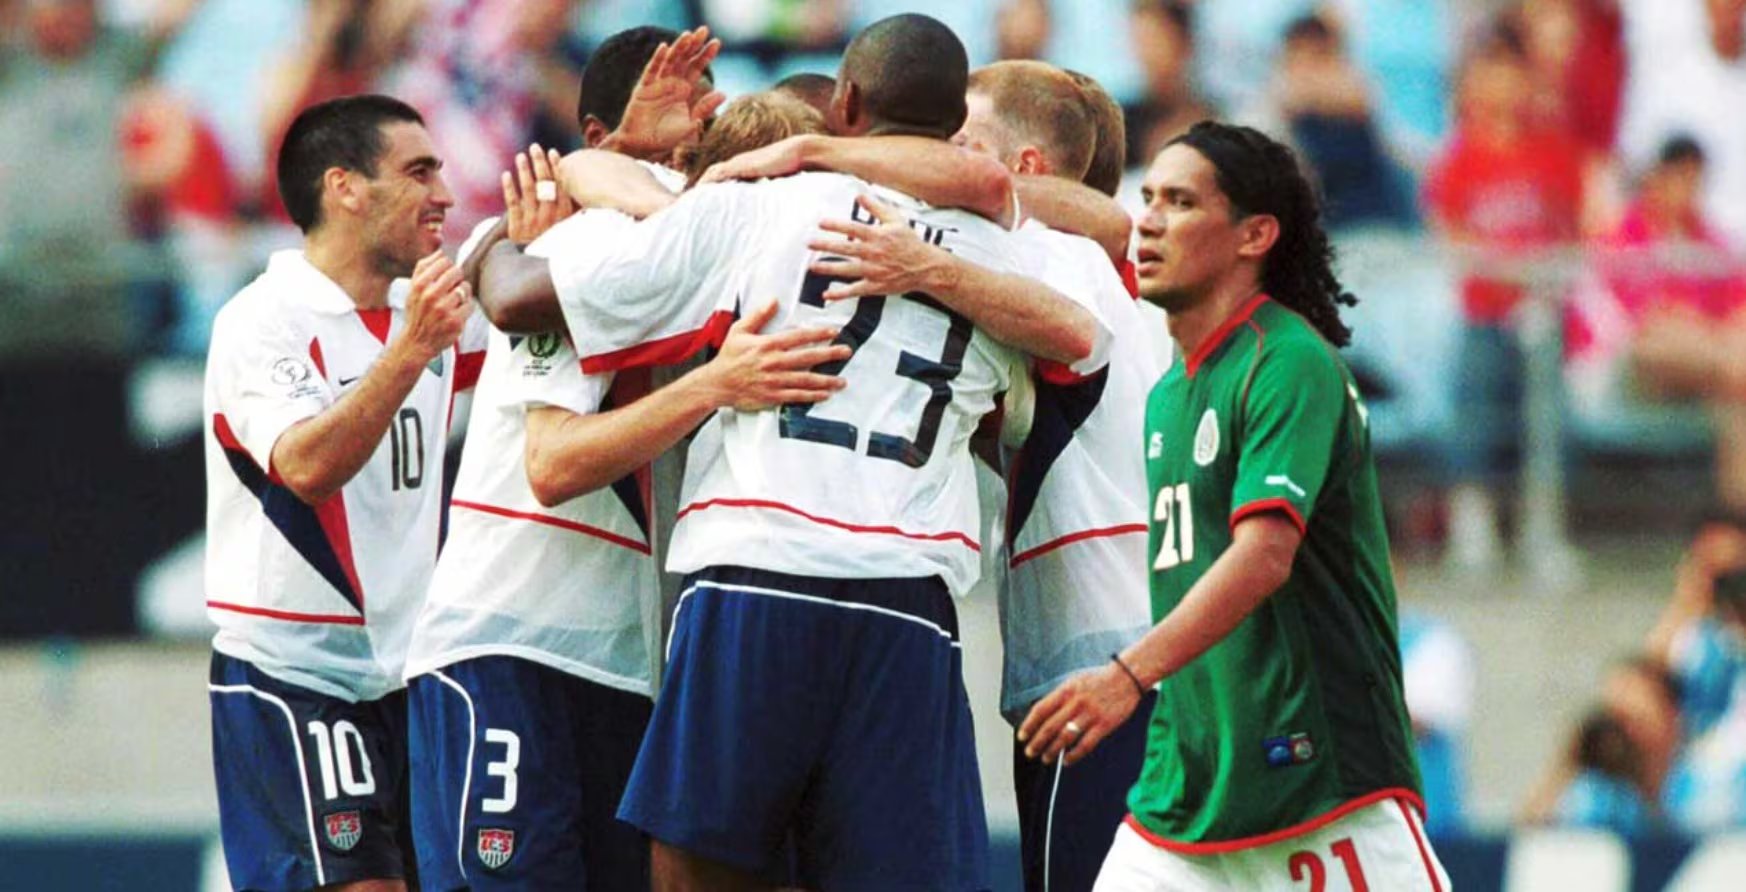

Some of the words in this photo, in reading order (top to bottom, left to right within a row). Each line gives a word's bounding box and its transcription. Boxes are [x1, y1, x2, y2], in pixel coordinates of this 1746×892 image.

[779, 256, 974, 469] 23
[390, 407, 424, 492] 10
[1152, 482, 1195, 571] 21
[306, 719, 376, 801] 10
[481, 727, 521, 813] 3
